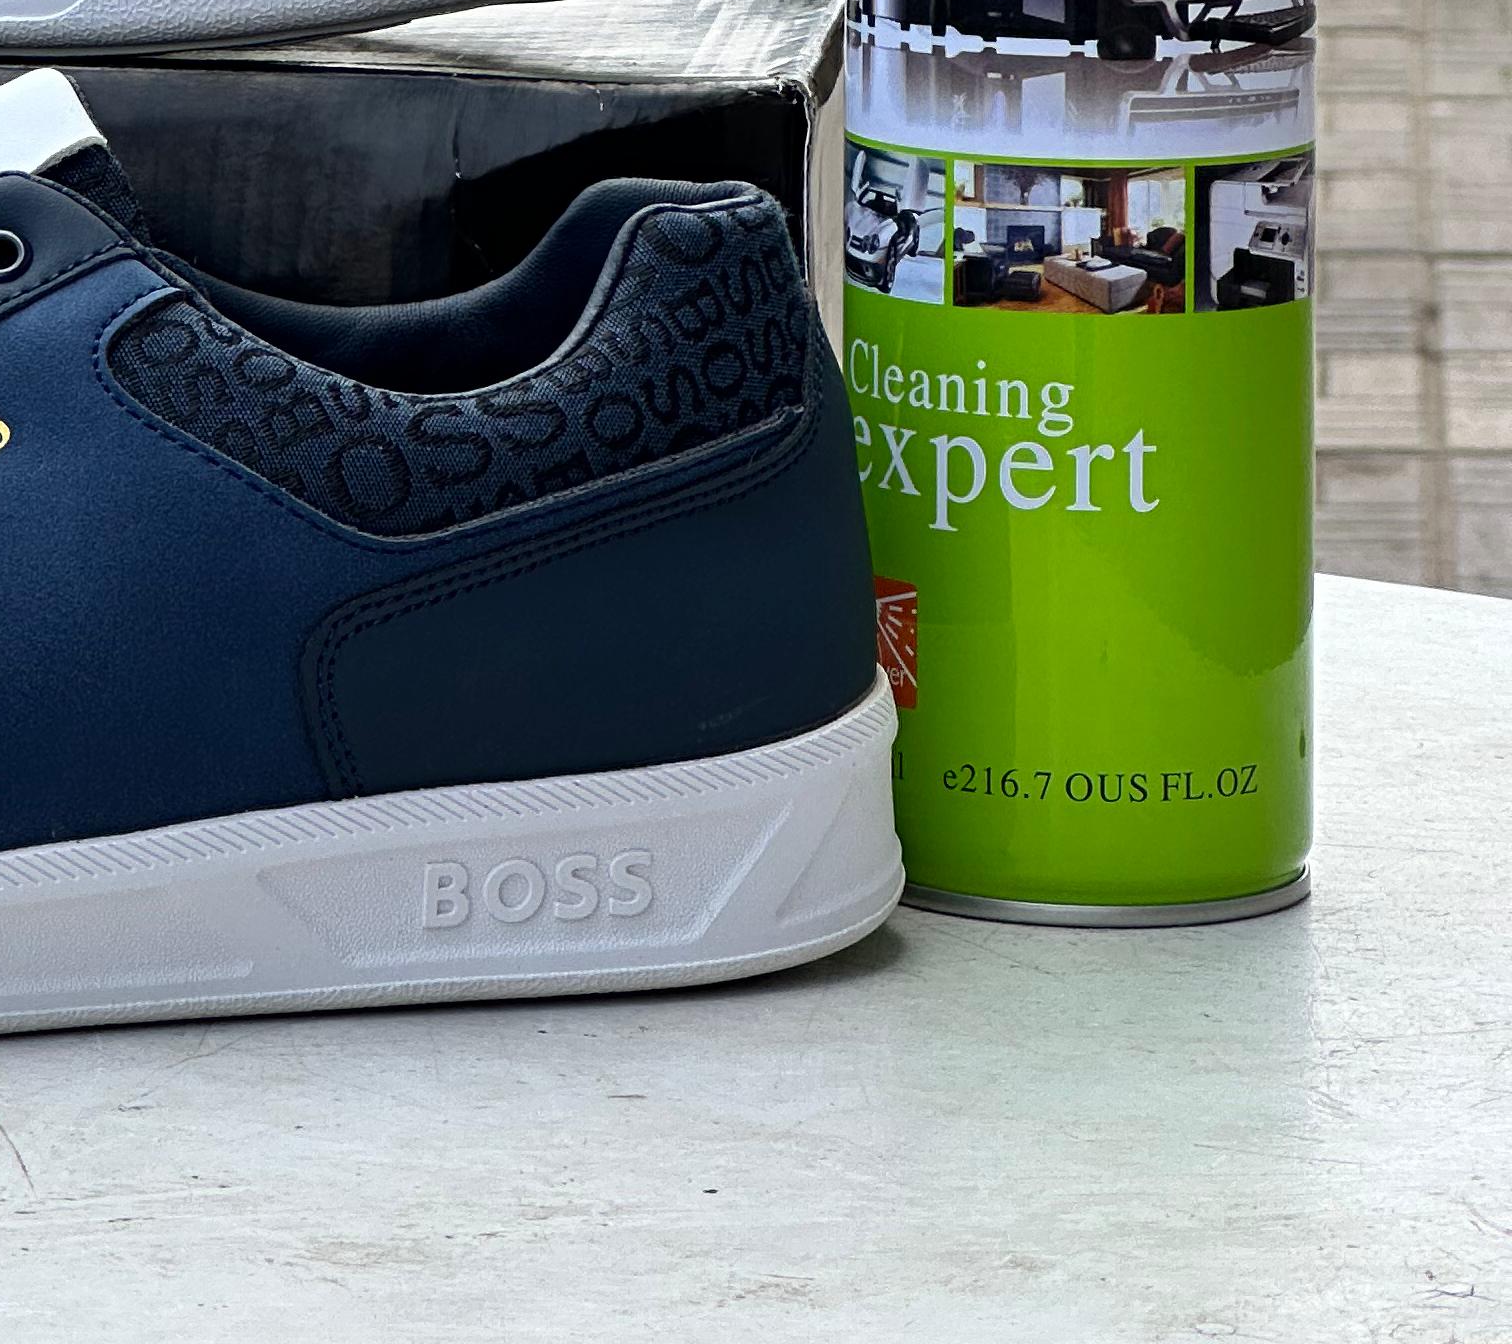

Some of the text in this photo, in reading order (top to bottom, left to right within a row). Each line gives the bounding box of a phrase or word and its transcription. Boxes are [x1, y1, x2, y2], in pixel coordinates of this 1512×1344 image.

[848, 337, 1076, 438] Cleaning
[1065, 772, 1148, 803] OUS
[1161, 764, 1259, 802] FL.OZ
[423, 849, 653, 928] BOSS
